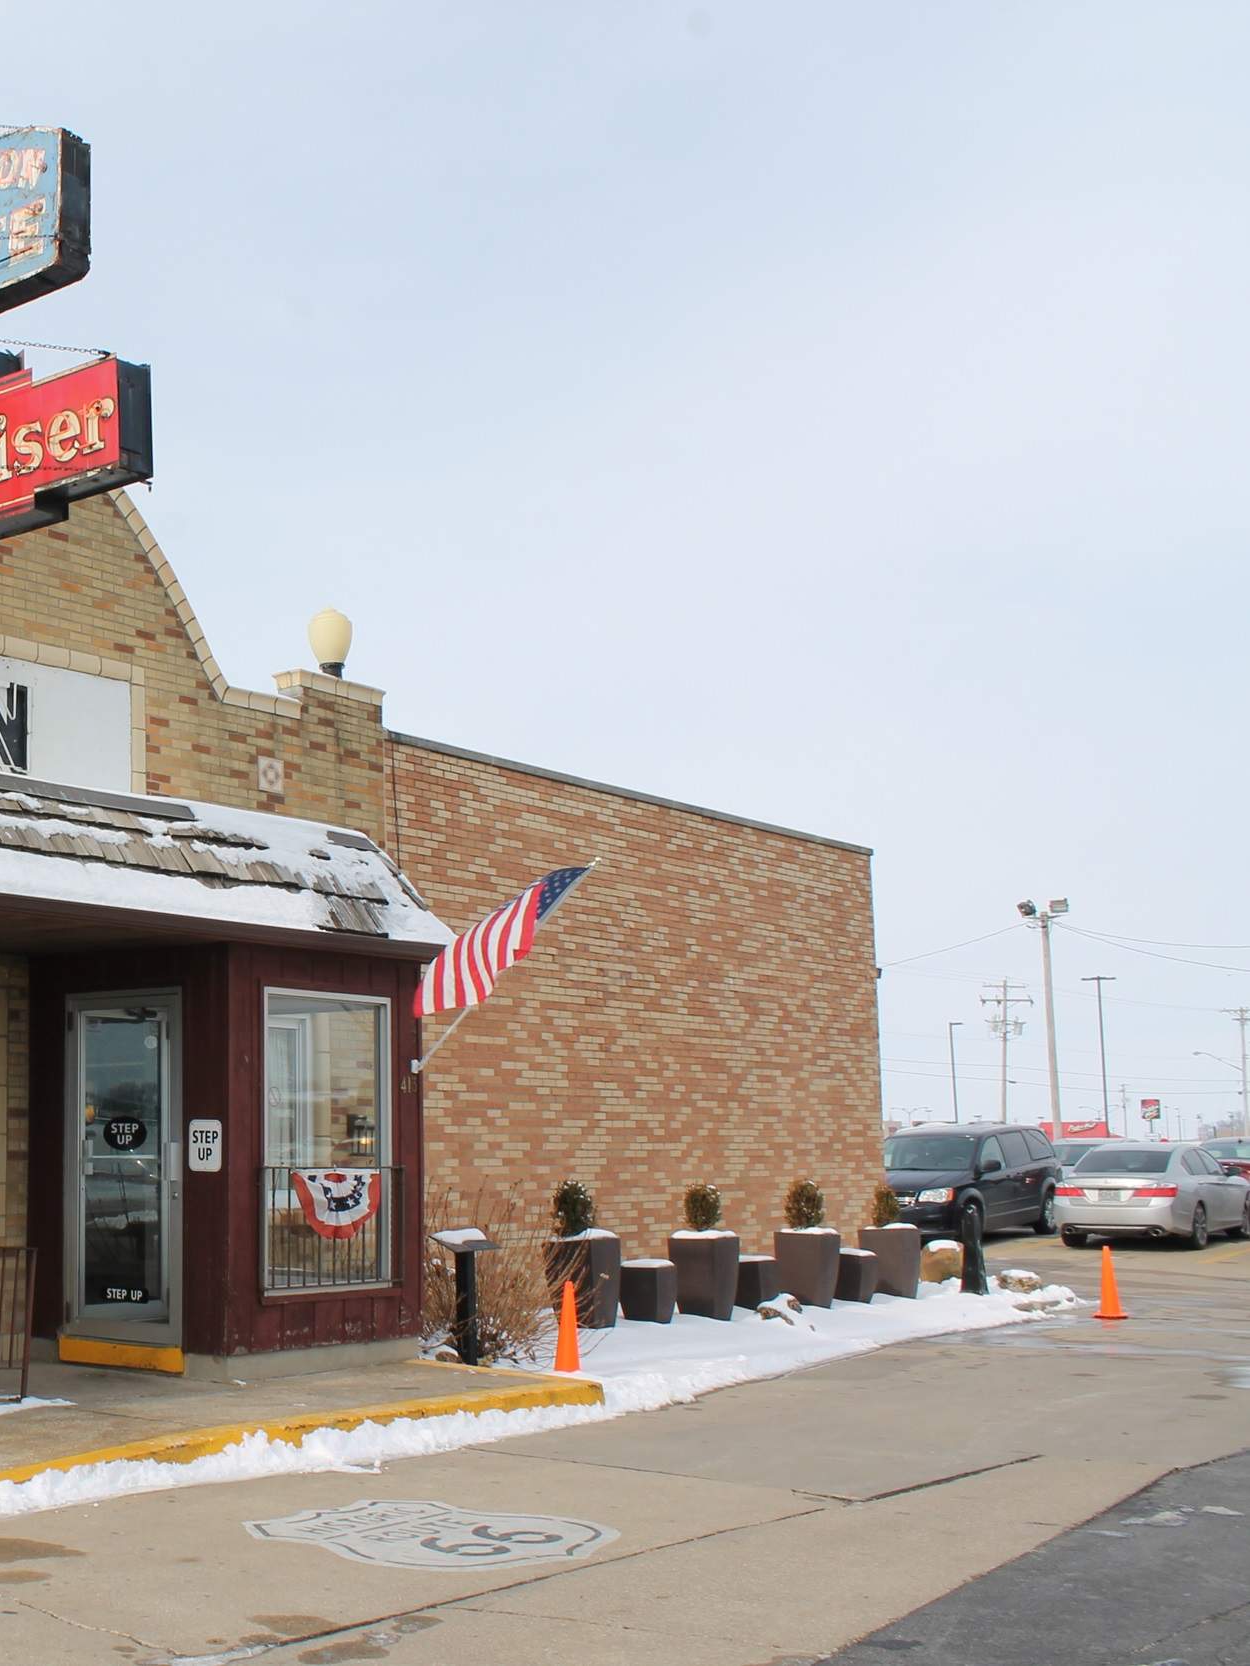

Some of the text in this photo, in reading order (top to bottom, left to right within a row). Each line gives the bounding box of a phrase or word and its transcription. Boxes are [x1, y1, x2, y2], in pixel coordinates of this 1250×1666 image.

[111, 1123, 139, 1134] STEP
[117, 1134, 133, 1145] UP
[192, 1130, 219, 1144] STEP
[197, 1147, 213, 1161] UP
[106, 1287, 143, 1301] STEP UP
[295, 1506, 426, 1535] HISTORIC
[359, 1517, 478, 1543] ROUTE
[419, 1524, 564, 1557] 66
